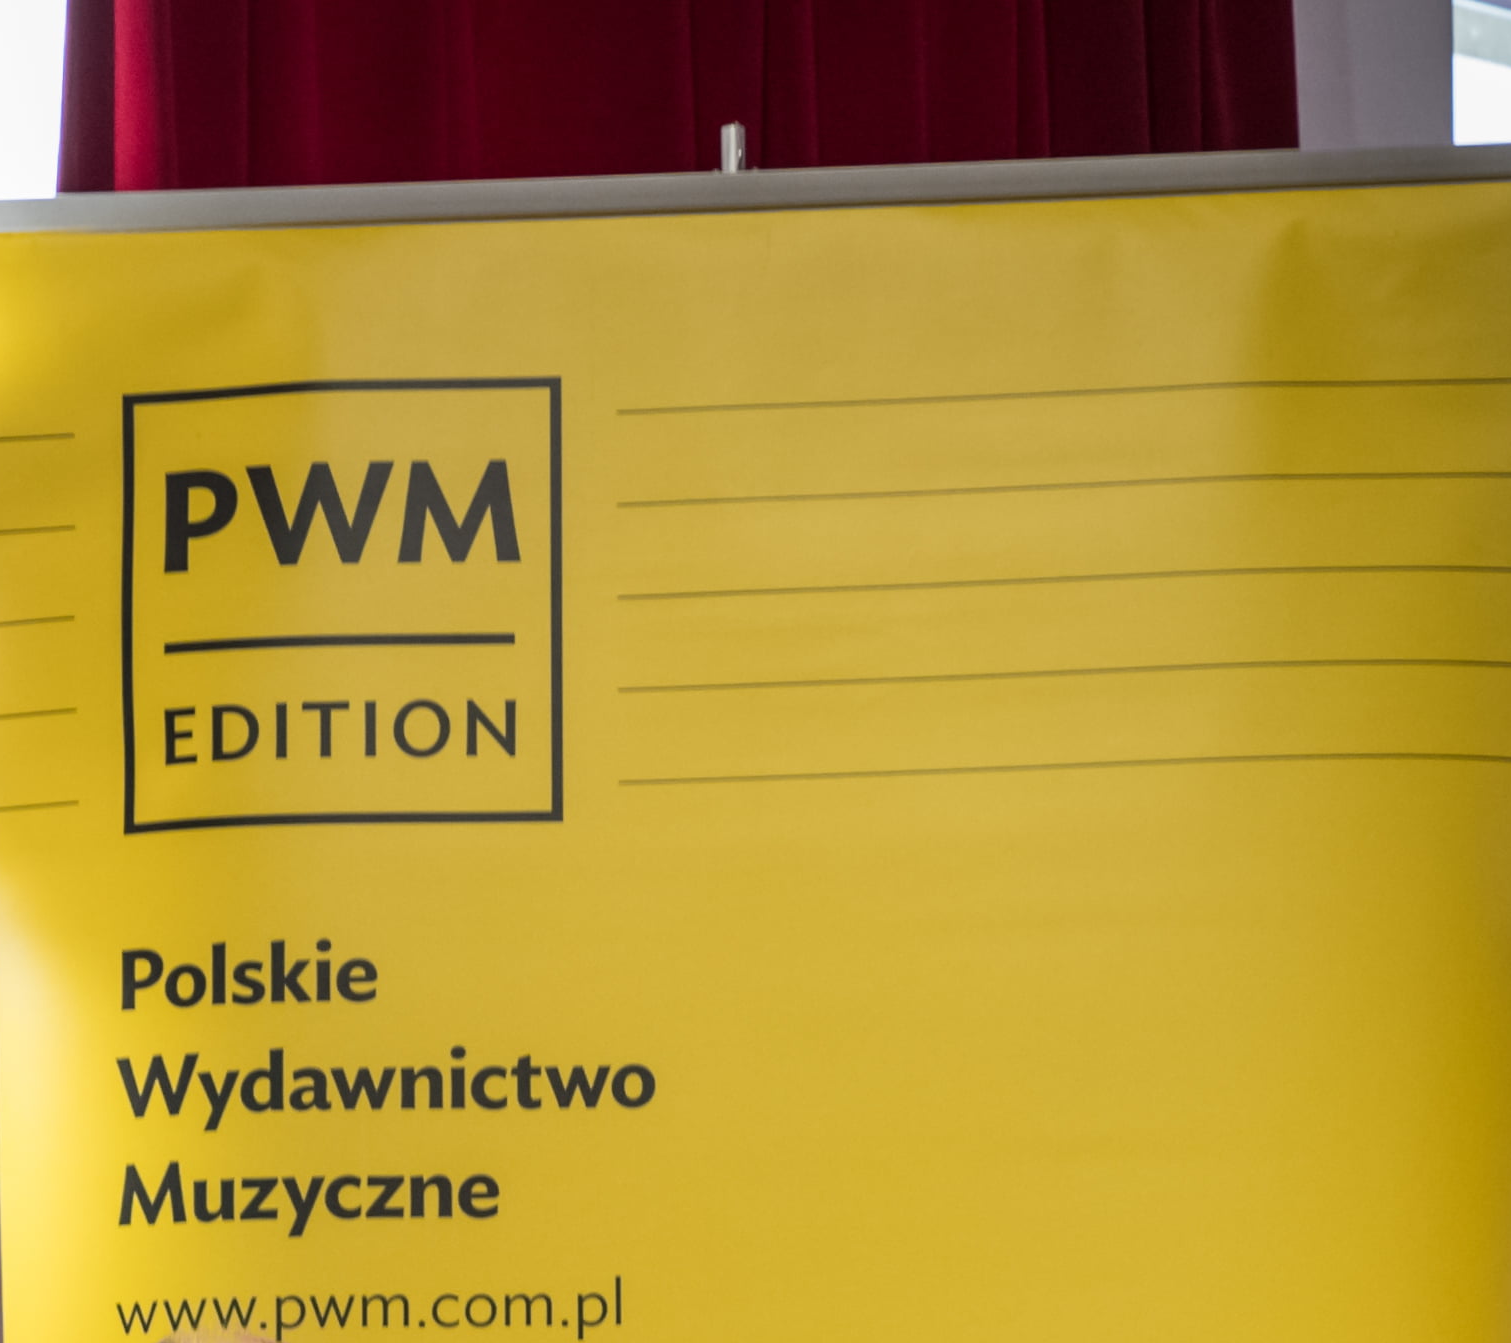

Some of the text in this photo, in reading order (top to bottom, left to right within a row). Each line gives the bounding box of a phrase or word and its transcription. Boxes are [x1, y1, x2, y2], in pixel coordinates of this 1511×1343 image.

[164, 458, 521, 573] PWM
[164, 699, 517, 765] EDITION
[121, 938, 378, 1010] Polskie
[116, 1045, 656, 1131] Wydawnictwo
[118, 1161, 500, 1237] Muzyczne
[116, 1275, 622, 1342] www.pwm.com.pl
